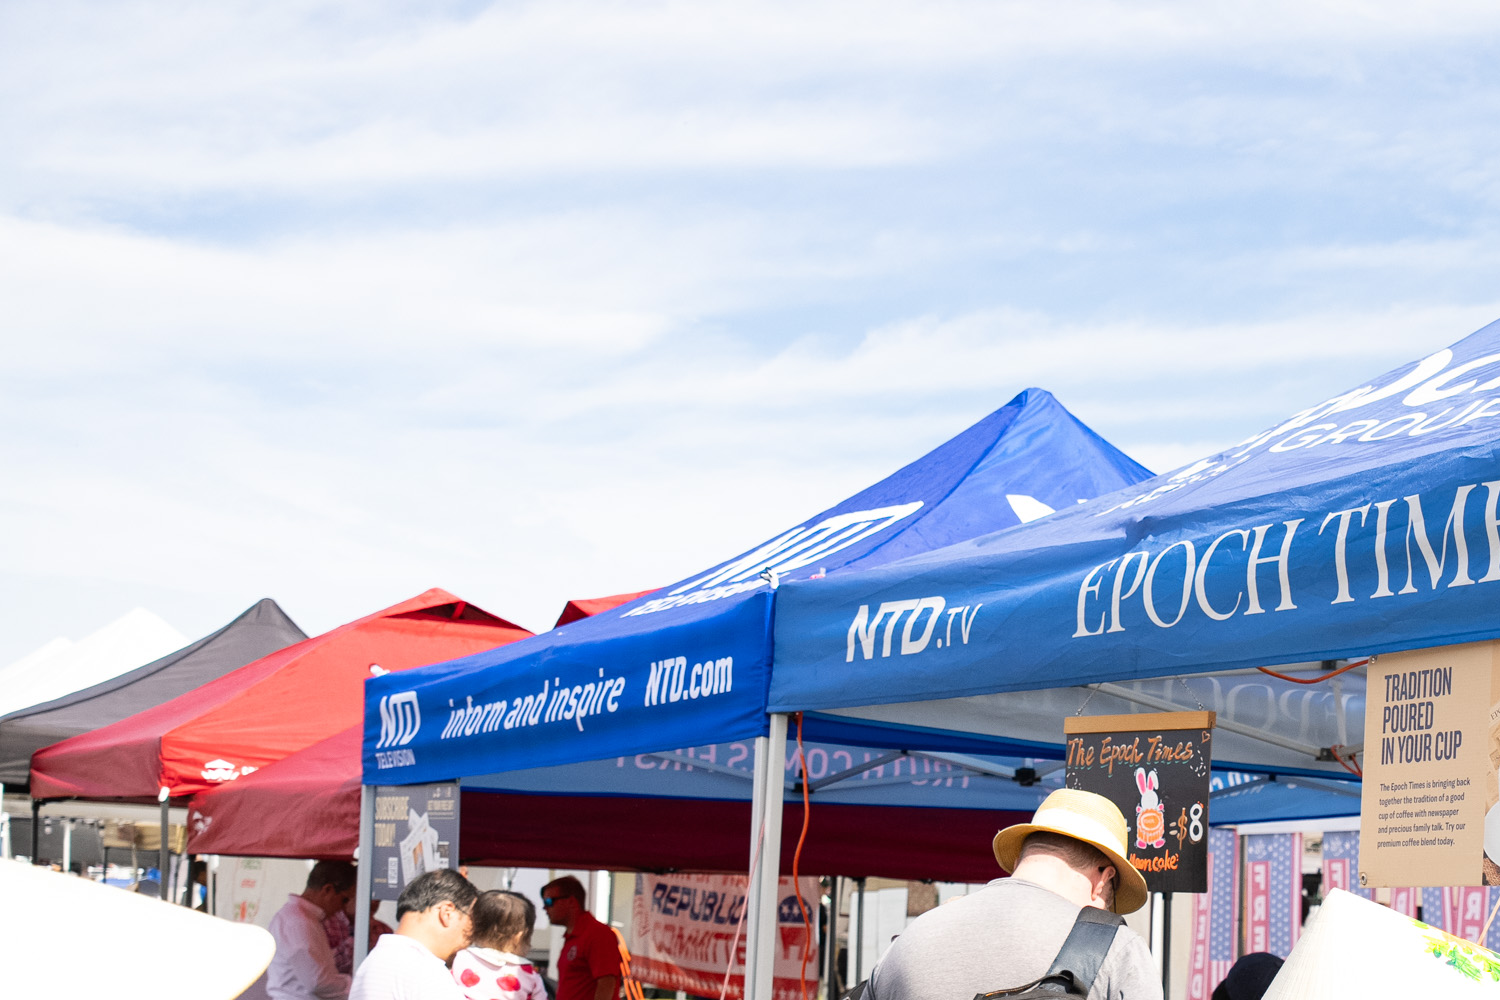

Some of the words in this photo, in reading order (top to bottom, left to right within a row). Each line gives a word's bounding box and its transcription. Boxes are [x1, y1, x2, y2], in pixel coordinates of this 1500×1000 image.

[1072, 516, 1306, 638] EPOCH
[846, 596, 982, 662] NTD.TV
[644, 655, 734, 708] NTD.com
[1384, 666, 1452, 703] TRADITION
[375, 690, 421, 748] NTD
[441, 695, 505, 739] inform
[503, 680, 549, 730] and
[545, 668, 626, 731] inspire
[1383, 701, 1434, 734] POURED
[375, 748, 416, 770] TELEVISION
[1067, 737, 1095, 766] The
[1100, 736, 1144, 775] Epoch
[1146, 735, 1194, 762] Times
[1381, 737, 1394, 766] IN
[1398, 734, 1432, 764] YOUR
[1434, 730, 1462, 761] CUP
[1379, 797, 1402, 807] together
[1403, 796, 1412, 804] the
[1413, 795, 1437, 804] tradition
[1438, 793, 1445, 801] of
[1450, 792, 1465, 803] good
[1380, 783, 1390, 791] The
[1391, 782, 1408, 792] Epoch
[1409, 781, 1425, 790] Times
[1426, 780, 1431, 789] is
[1432, 779, 1455, 789] bringing
[1456, 777, 1470, 787] back
[1378, 812, 1388, 821] cup
[1389, 811, 1395, 819] of
[1396, 810, 1413, 819] coffee
[1414, 809, 1427, 817] with
[1428, 809, 1459, 818] newspaper
[1378, 825, 1388, 834] and
[1388, 824, 1412, 835] precious
[1413, 823, 1430, 833] family
[1431, 822, 1444, 831] talk.
[1445, 822, 1455, 832] Try
[1377, 839, 1401, 849] premium
[1402, 838, 1420, 847] coffee
[1420, 837, 1436, 846] blend
[1437, 836, 1455, 846] today.
[651, 883, 749, 926] REPUBLIC
[652, 921, 747, 966] COMMITTE
